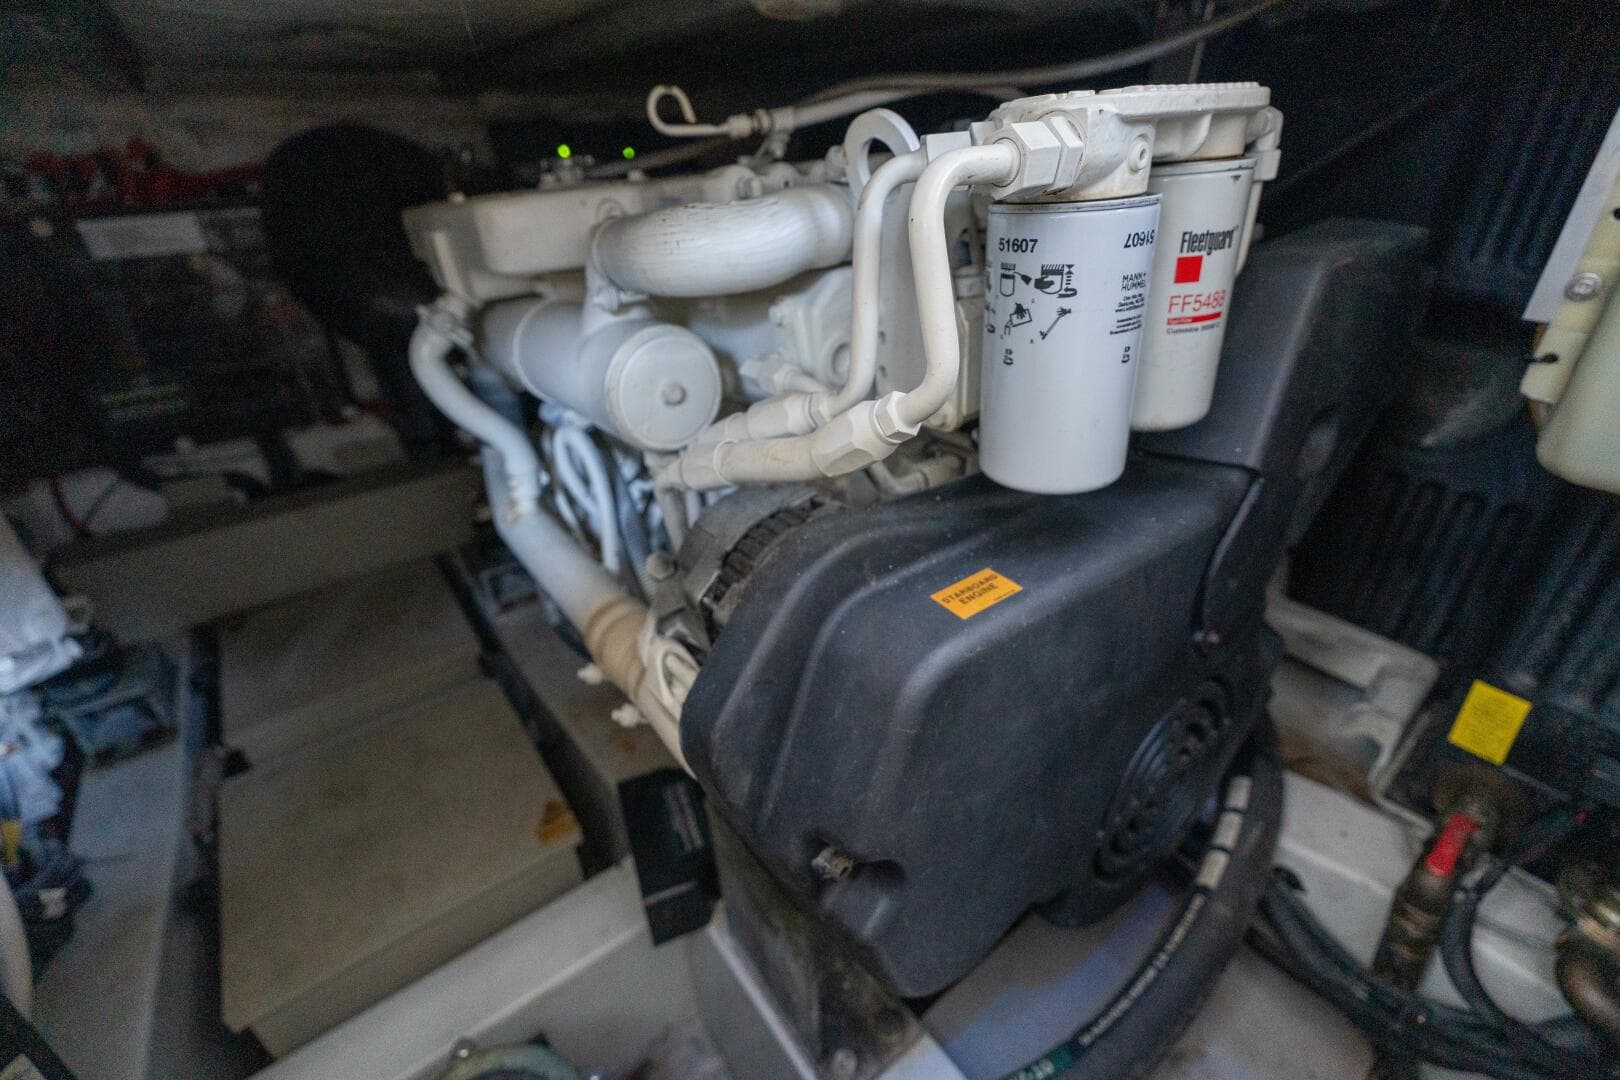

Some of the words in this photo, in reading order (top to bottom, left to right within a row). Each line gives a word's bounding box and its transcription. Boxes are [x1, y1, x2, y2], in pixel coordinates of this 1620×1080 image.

[998, 238, 1038, 253] 51607
[1123, 229, 1155, 249] 51607
[959, 582, 998, 605] ENGINE
